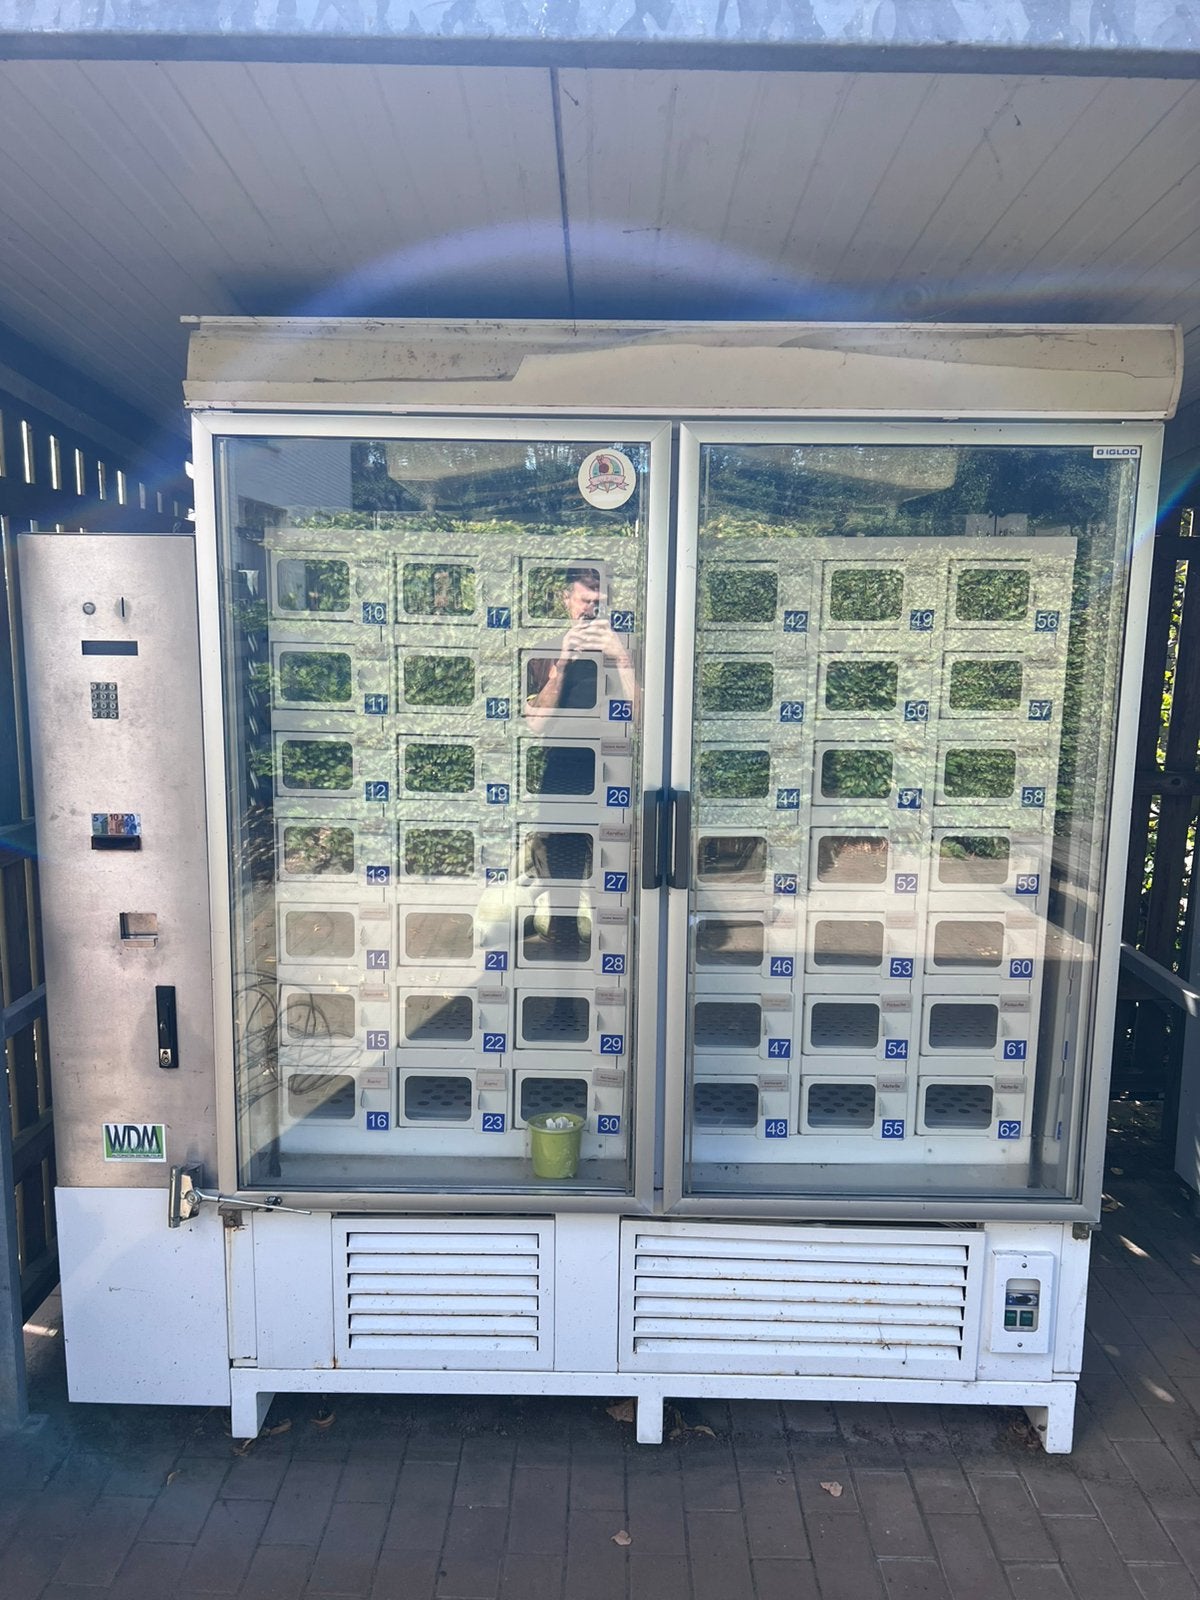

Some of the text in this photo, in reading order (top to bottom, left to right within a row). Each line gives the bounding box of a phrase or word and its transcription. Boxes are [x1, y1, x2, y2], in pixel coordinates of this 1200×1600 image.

[366, 606, 384, 621] 10
[490, 610, 509, 624] 17
[912, 612, 931, 626] 49
[614, 615, 632, 628] 24
[787, 613, 806, 628] 42
[1036, 614, 1056, 628] 56
[369, 698, 384, 711] 11
[490, 702, 507, 714] 18
[612, 703, 631, 718] 25
[782, 704, 802, 718] 43
[907, 704, 927, 717] 50
[1030, 703, 1050, 717] 57
[368, 785, 386, 798] 12
[490, 787, 507, 800] 19
[609, 790, 628, 804] 26
[1024, 790, 1042, 803] 58
[779, 792, 797, 805] 44
[93, 813, 136, 822] 5 10 20
[369, 869, 386, 883] 13
[489, 872, 506, 885] 20
[607, 875, 625, 888] 27
[776, 878, 795, 890] 45
[897, 877, 915, 891] 52
[1018, 877, 1037, 890] 59
[369, 953, 387, 966] 14
[488, 954, 504, 967] 21
[605, 957, 623, 970] 28
[773, 960, 791, 973] 46
[892, 961, 911, 974] 53
[1012, 961, 1031, 974] 60
[369, 1034, 386, 1047] 15
[486, 1036, 503, 1050] 22
[603, 1038, 621, 1051] 29
[770, 1042, 788, 1055] 47
[888, 1043, 906, 1055] 54
[1007, 1043, 1024, 1056] 61
[369, 1115, 386, 1128] 16
[484, 1117, 502, 1129] 23
[601, 1119, 619, 1131] 30
[767, 1123, 785, 1135] 48
[884, 1123, 902, 1135] 55
[1000, 1123, 1019, 1136] 62
[105, 1124, 161, 1153] WDM
